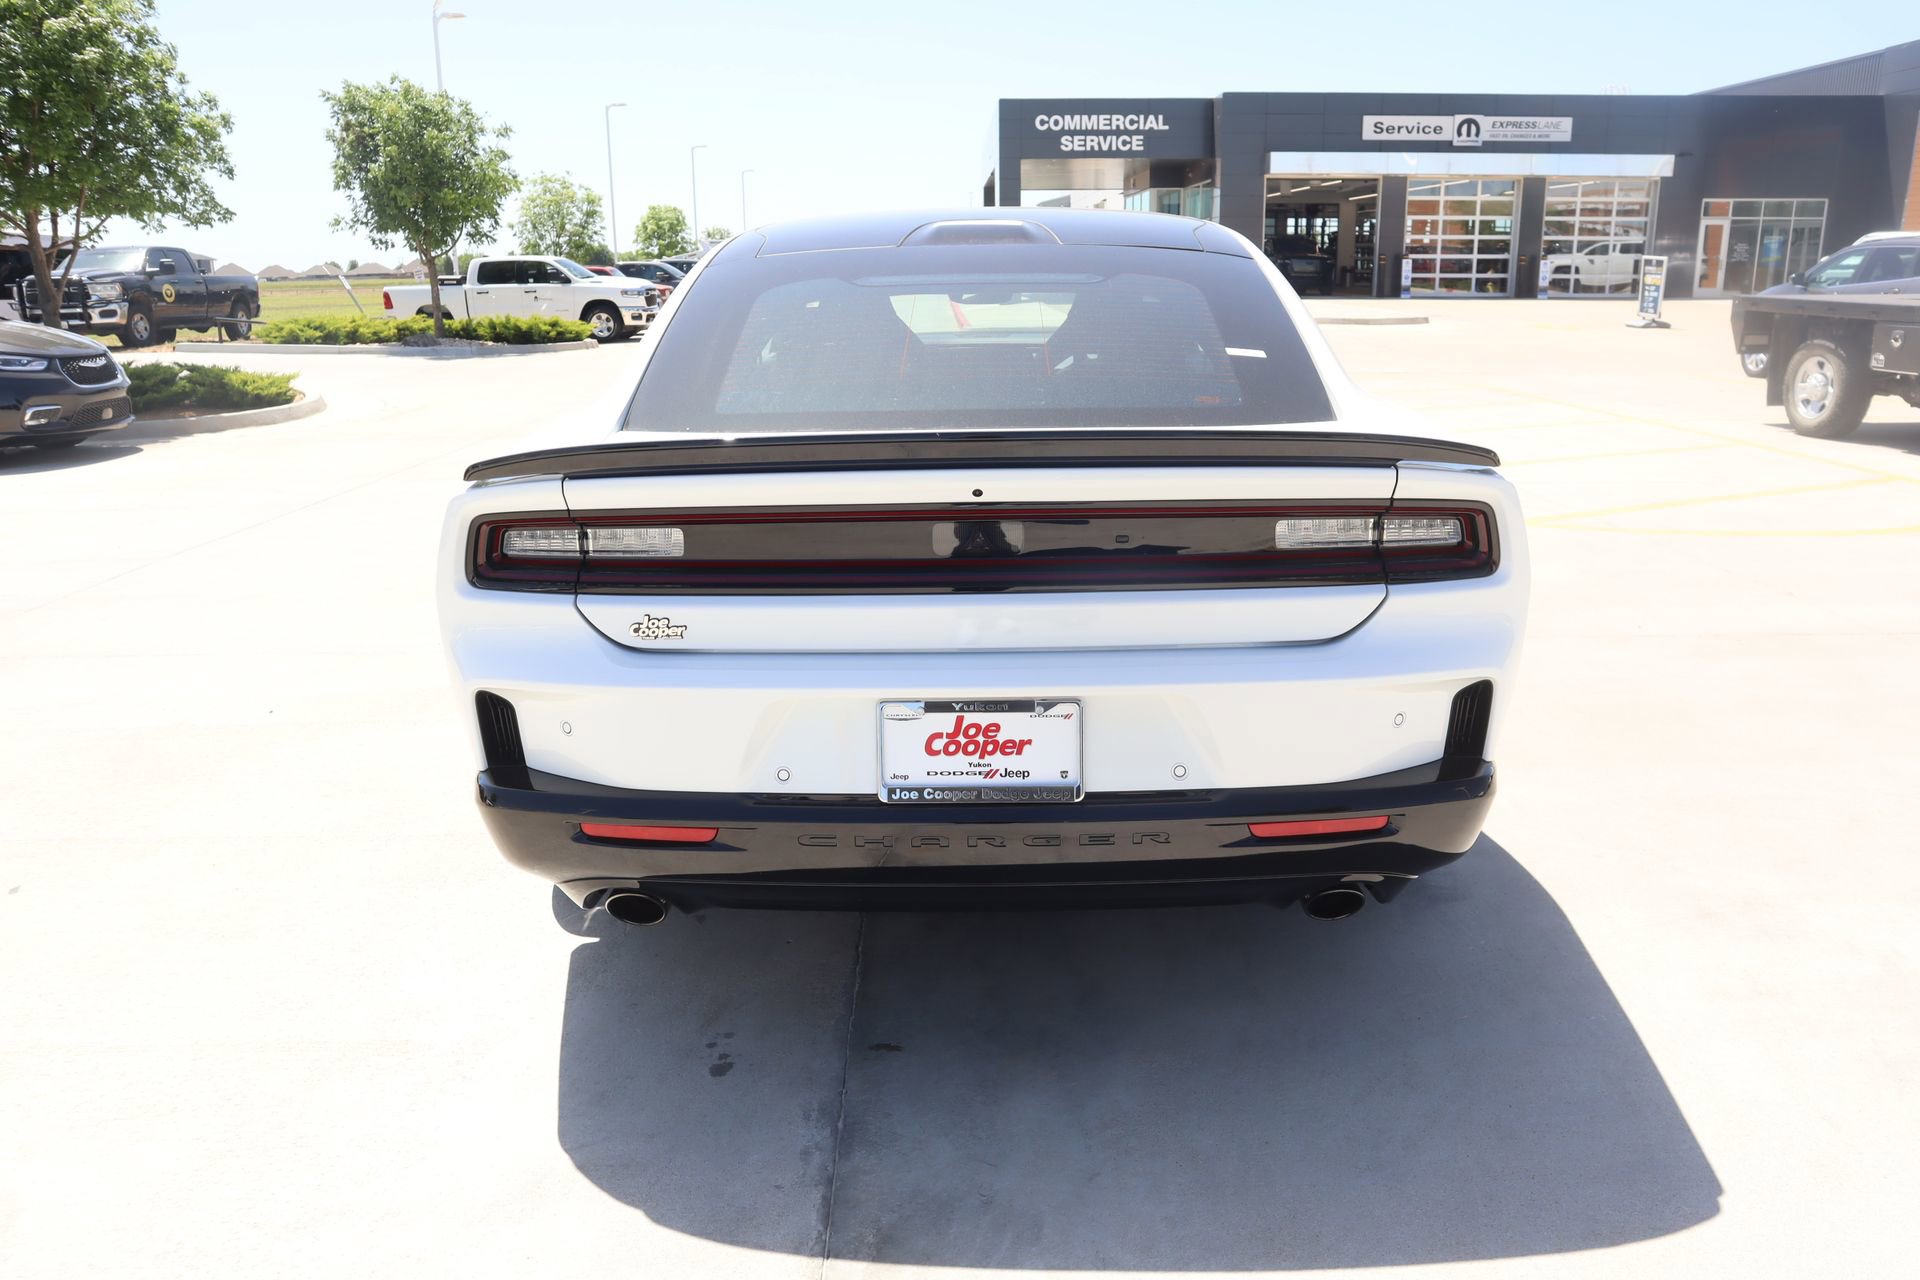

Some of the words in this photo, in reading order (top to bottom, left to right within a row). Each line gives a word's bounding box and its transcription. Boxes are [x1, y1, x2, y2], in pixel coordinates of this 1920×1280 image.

[1034, 114, 1169, 131] COMMERCIAL
[1373, 121, 1444, 135] Service
[1060, 135, 1144, 151] SERVICE
[639, 614, 670, 629] Joe
[629, 623, 687, 638] Cooper
[952, 702, 1009, 711] Yukon
[946, 715, 1001, 740] Joe
[924, 732, 1033, 760] Cooper
[890, 773, 909, 781] Jeep
[999, 767, 1030, 780] Jeep
[891, 788, 919, 800] Joe
[923, 788, 978, 801] Cooper
[982, 788, 1029, 801] Dodge
[1033, 788, 1071, 801] Jeep
[797, 831, 1172, 848] CHARGER
